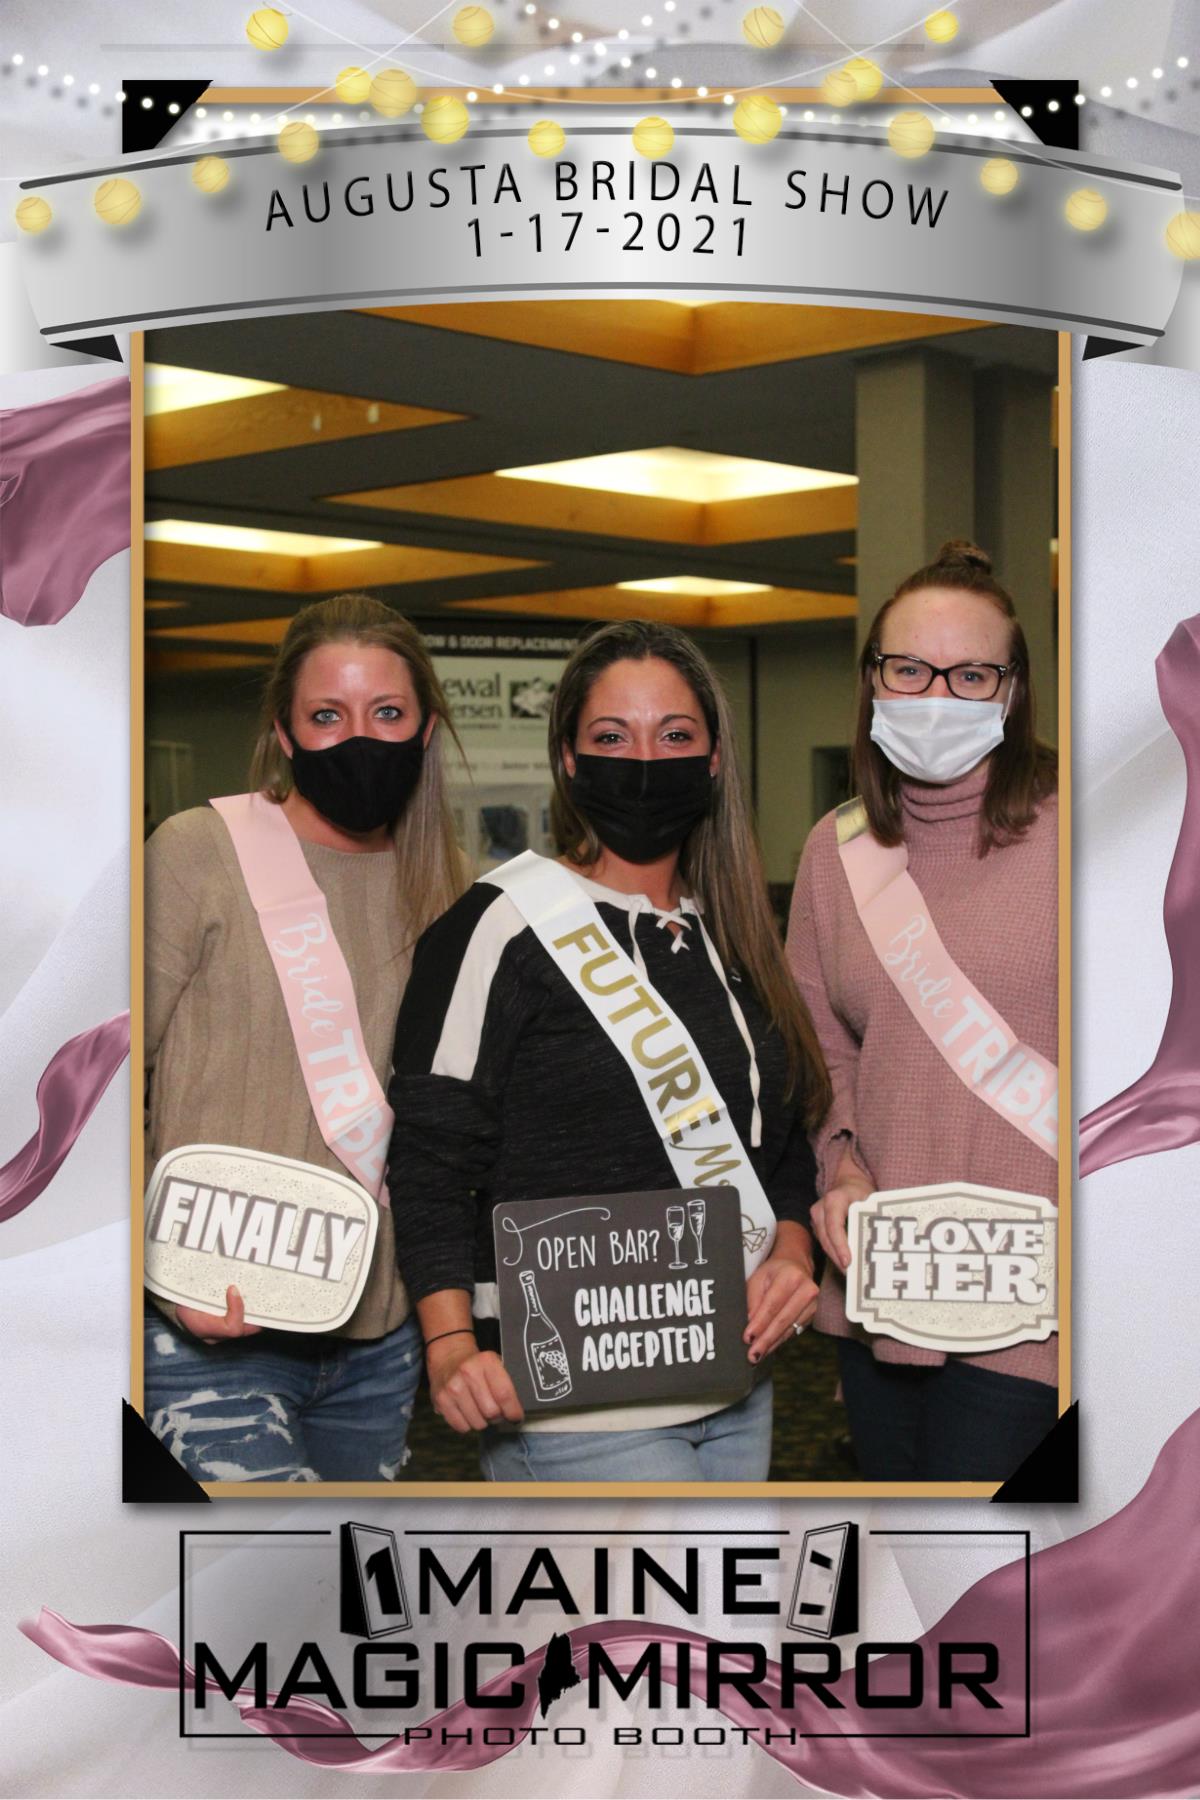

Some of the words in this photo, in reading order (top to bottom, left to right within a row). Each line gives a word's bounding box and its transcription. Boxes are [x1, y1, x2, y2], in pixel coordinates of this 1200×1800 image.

[272, 912, 344, 1038] Bride
[884, 914, 953, 1019] Bride
[552, 922, 721, 1145] FUTURE
[150, 1175, 366, 1283] FINALLY
[537, 1235, 596, 1271] OPEN
[609, 1228, 661, 1265] BAR?
[574, 1278, 716, 1327] CHALLENGE
[865, 1250, 1048, 1305] HER
[582, 1321, 716, 1372] ACCEPTED!
